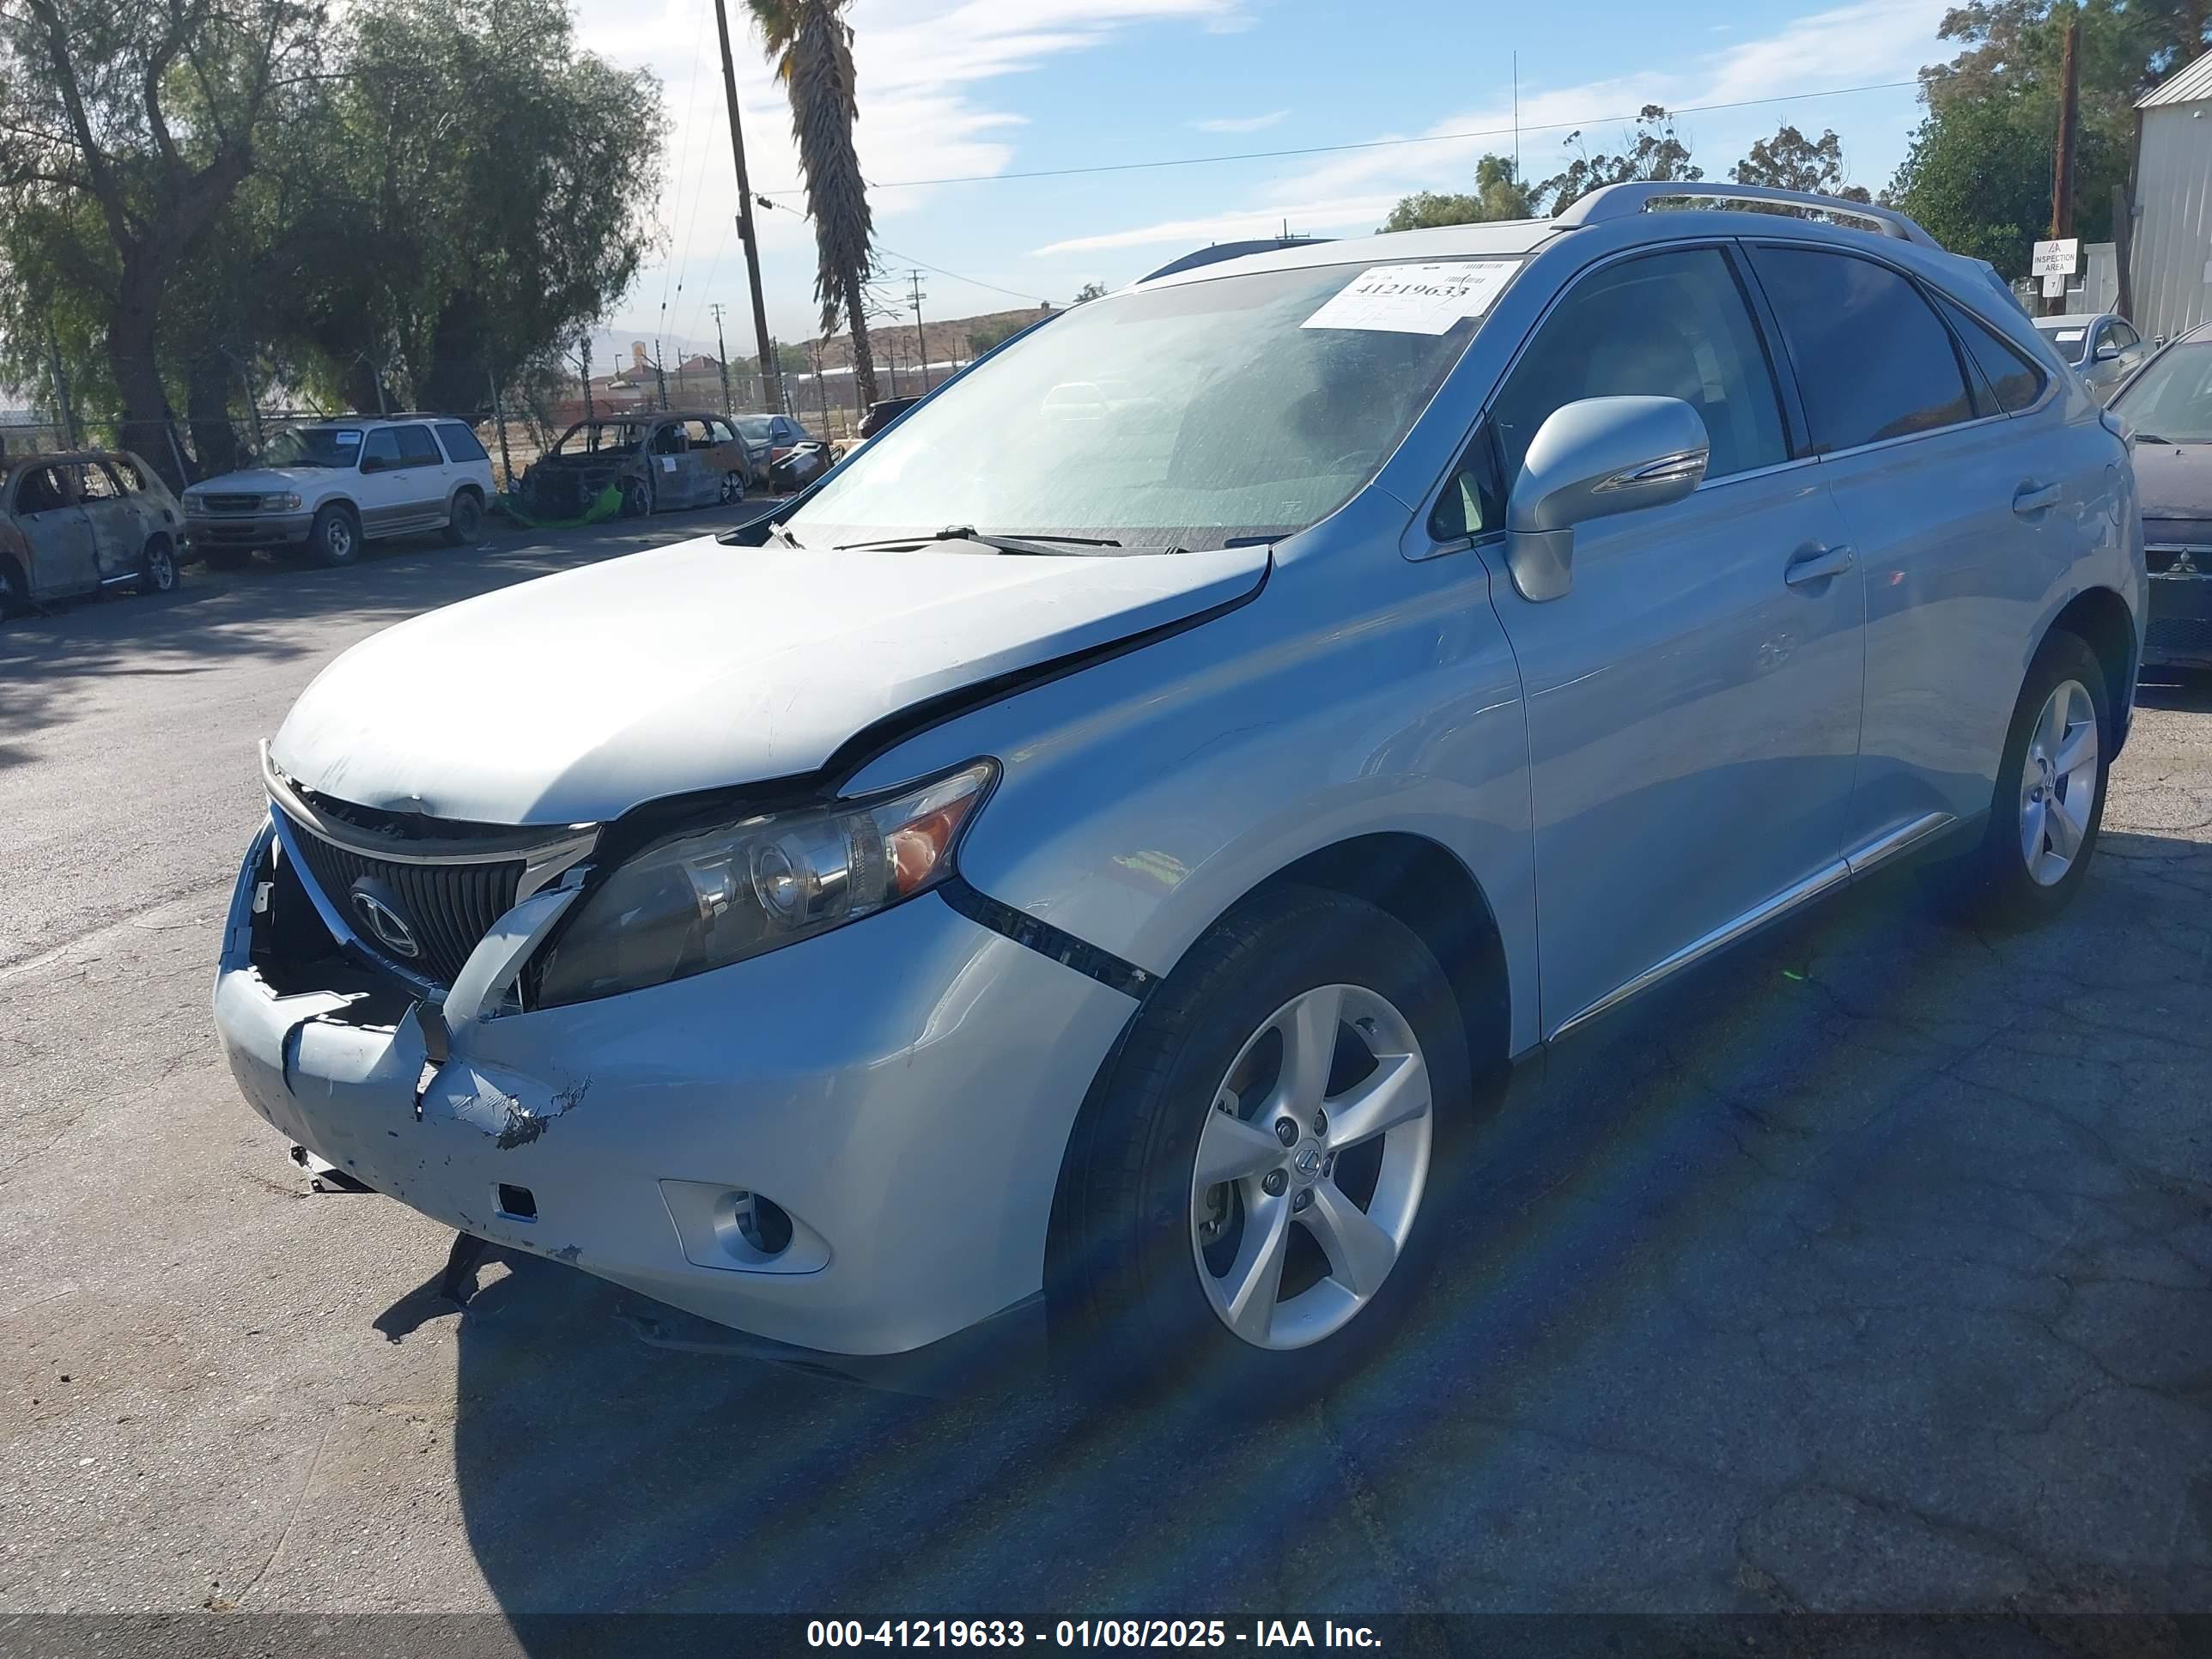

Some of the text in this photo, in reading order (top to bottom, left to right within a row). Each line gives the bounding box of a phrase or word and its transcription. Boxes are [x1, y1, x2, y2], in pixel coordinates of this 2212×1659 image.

[2034, 253, 2075, 264] INSPECTION
[2045, 263, 2064, 271] AREA
[1356, 283, 1470, 298] 41219633
